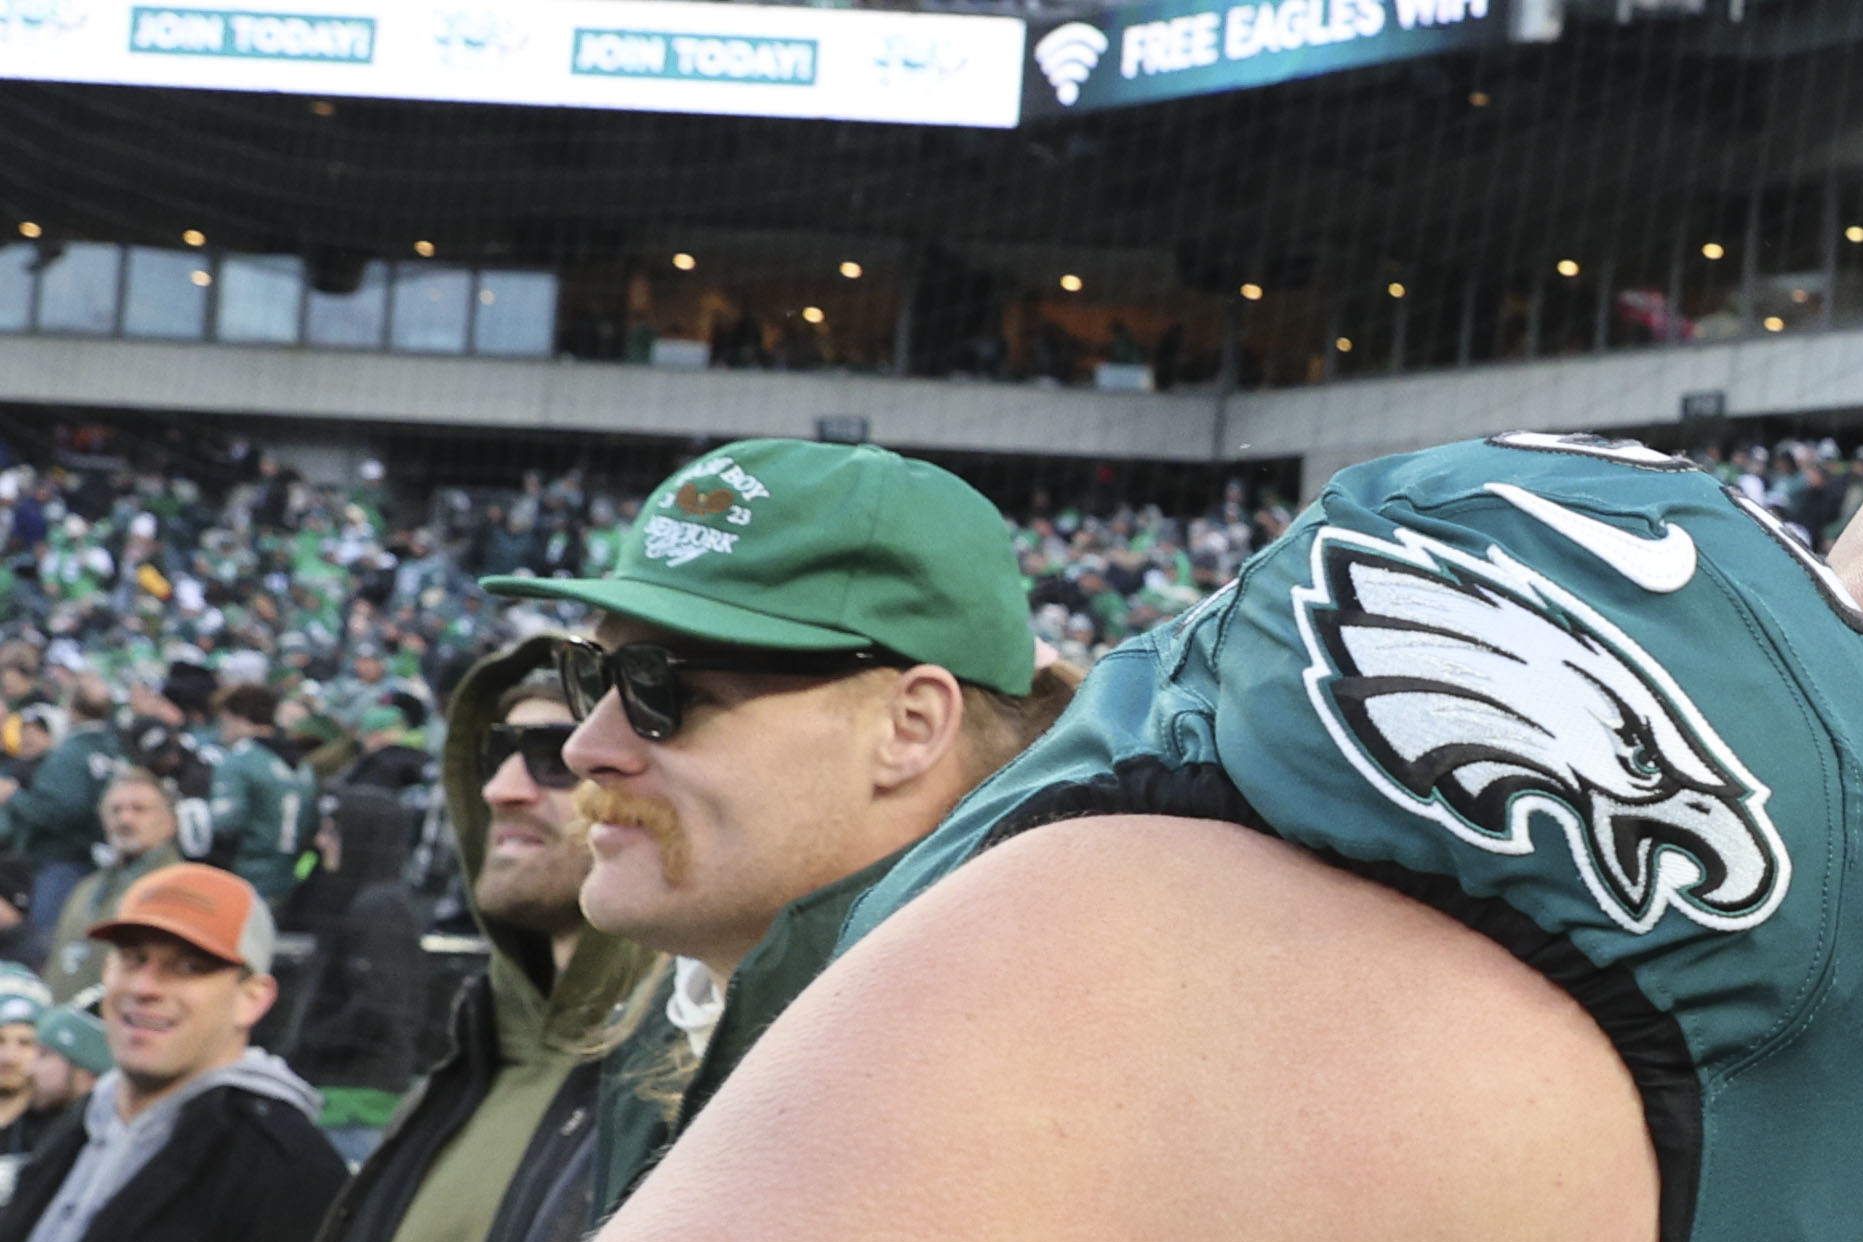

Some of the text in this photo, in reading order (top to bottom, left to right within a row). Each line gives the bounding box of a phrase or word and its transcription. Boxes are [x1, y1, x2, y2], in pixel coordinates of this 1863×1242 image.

[135, 11, 224, 51] JOIN
[231, 15, 371, 59] TODAY!
[576, 32, 665, 74] JOIN
[671, 36, 812, 82] TODAY!
[1120, 11, 1220, 79] FREE
[1225, 0, 1385, 60] EAGLES
